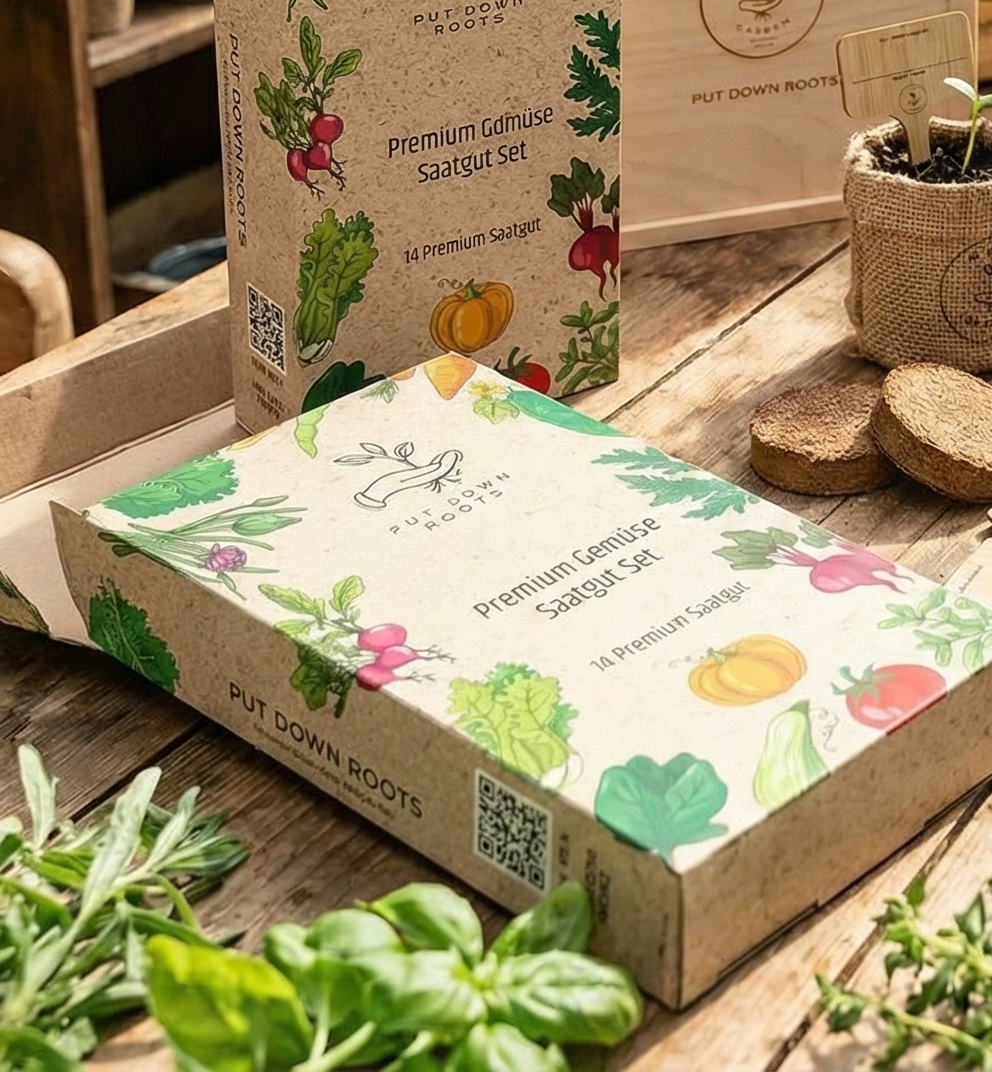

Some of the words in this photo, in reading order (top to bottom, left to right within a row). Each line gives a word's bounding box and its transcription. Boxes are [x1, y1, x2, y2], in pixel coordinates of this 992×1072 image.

[414, 9, 453, 26] PUT
[435, 13, 504, 35] ROOTS
[230, 33, 240, 83] PUT
[691, 90, 723, 104] PUT
[729, 83, 779, 100] DOWN
[784, 75, 840, 92] ROOTS
[232, 88, 244, 163] DOWN
[388, 124, 476, 158] Premium
[418, 149, 493, 183] Saatgut
[498, 140, 527, 165] Set
[235, 166, 247, 247] ROOTS
[404, 248, 419, 264] 14
[423, 233, 486, 260] Premium
[489, 218, 542, 243] Saatgut
[389, 508, 432, 534] PUT
[447, 472, 510, 506] DOWN
[424, 490, 503, 531] ROOTS
[473, 561, 578, 619] Premium
[572, 517, 661, 566] Gemüse
[535, 568, 627, 620] Saatgut
[617, 549, 663, 574] Set
[590, 656, 615, 672] 14
[611, 615, 690, 661] Premium
[229, 682, 267, 719] PUT
[275, 710, 340, 767] DOWN
[348, 757, 422, 818] ROOTS
